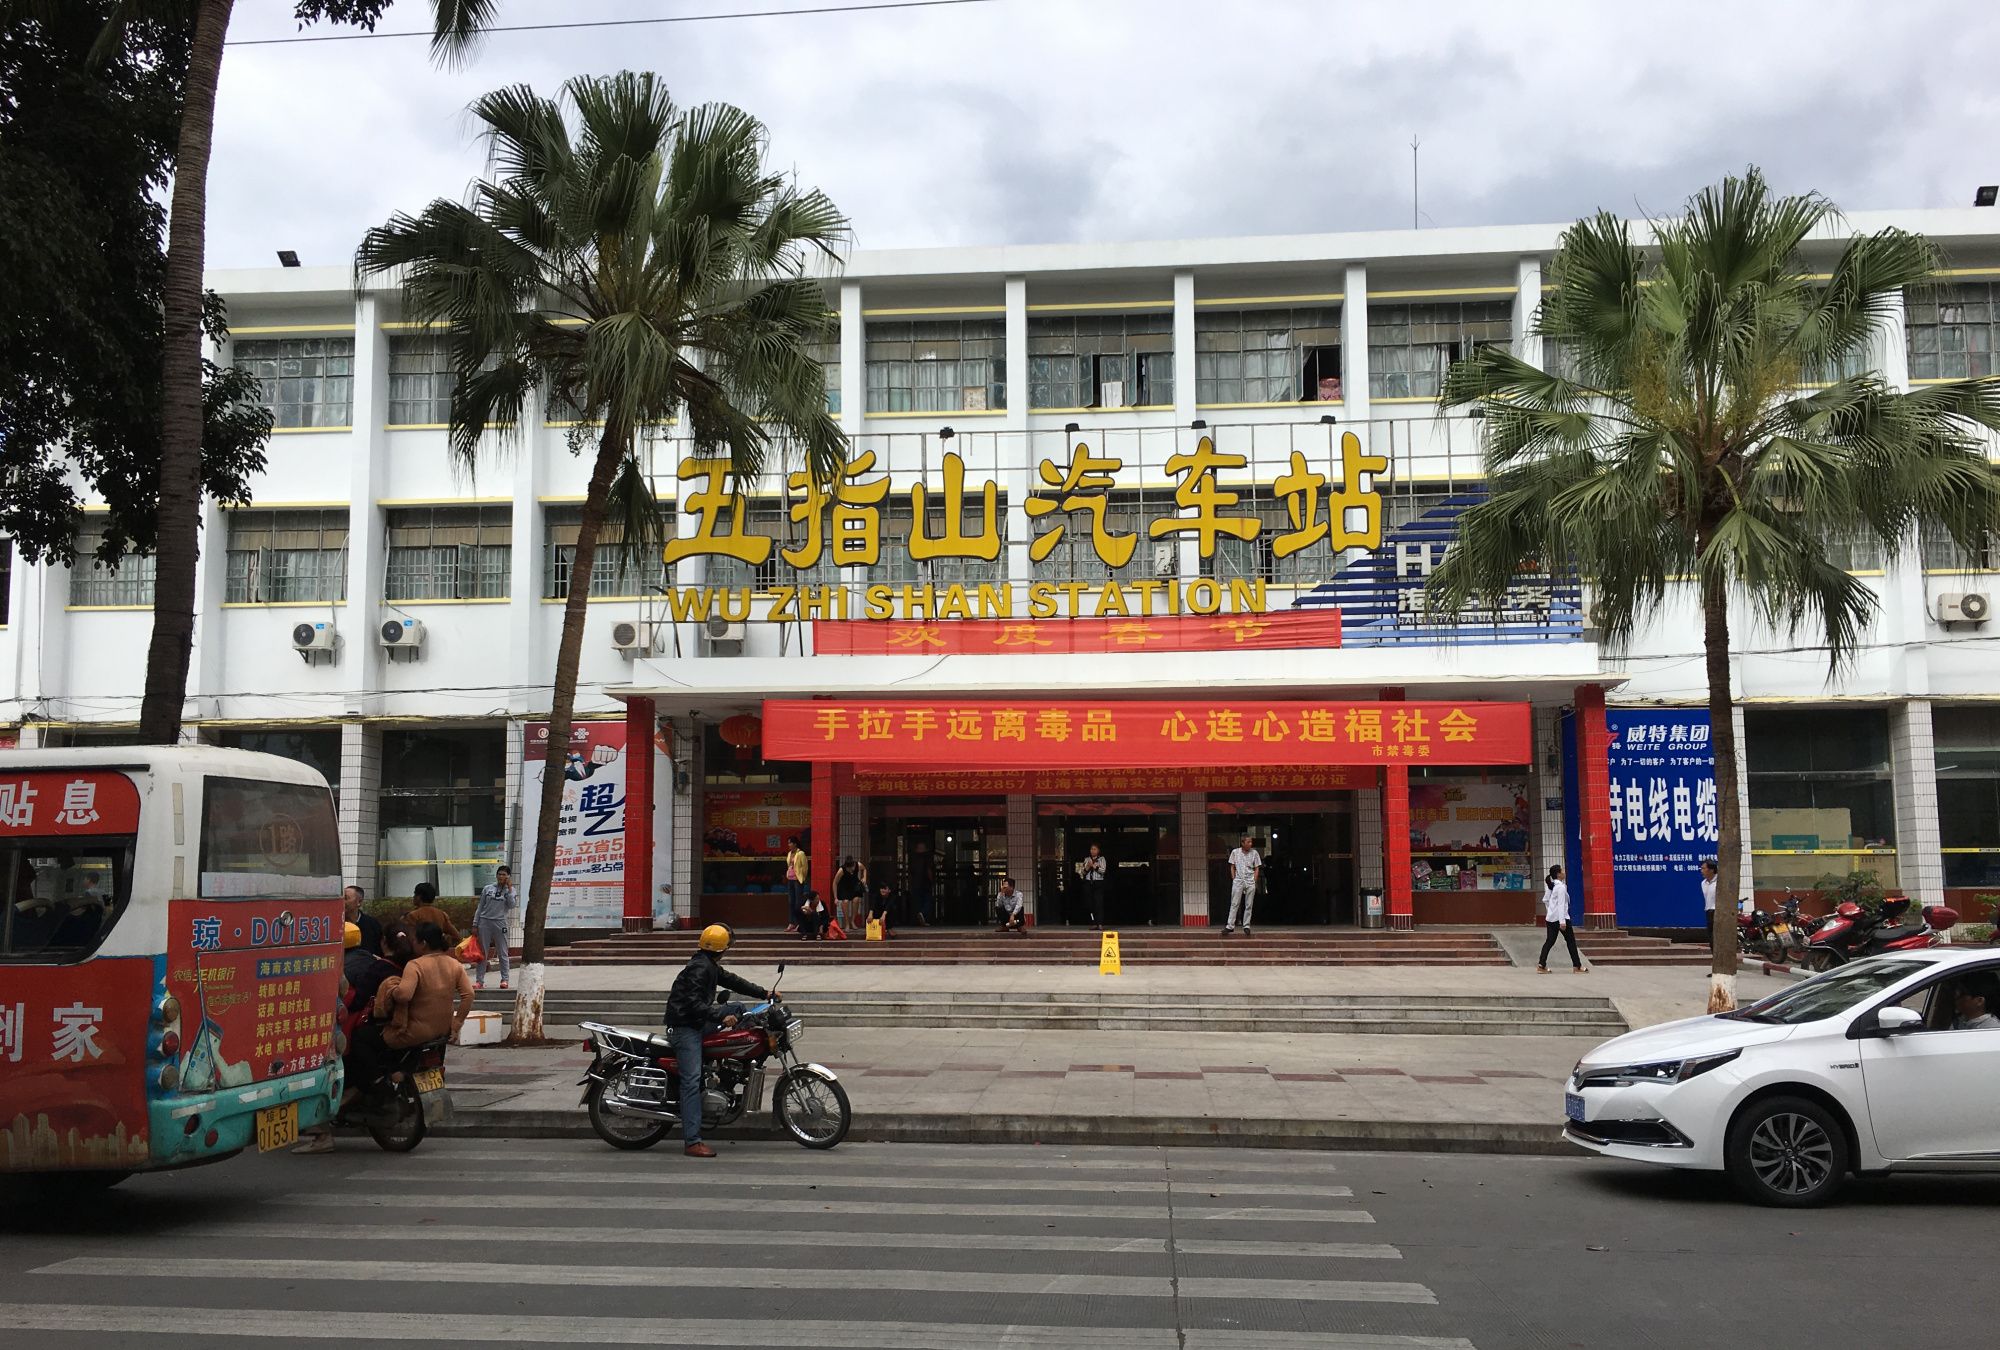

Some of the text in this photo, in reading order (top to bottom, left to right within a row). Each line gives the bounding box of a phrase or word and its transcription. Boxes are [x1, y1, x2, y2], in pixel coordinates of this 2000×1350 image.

[663, 431, 1389, 570] 五指山汽车站
[667, 576, 1268, 622] WU ZHI SHAN STATION
[885, 619, 1271, 649] 欢度春节
[813, 707, 1478, 743] 手拉手远离毒品 心连心造福社会
[1626, 724, 1710, 743] 威特集团
[1371, 744, 1431, 757] 市禁毒委
[1627, 743, 1661, 751] WEITE
[1668, 743, 1708, 751] GROUP
[259, 1119, 294, 1151] 01531
